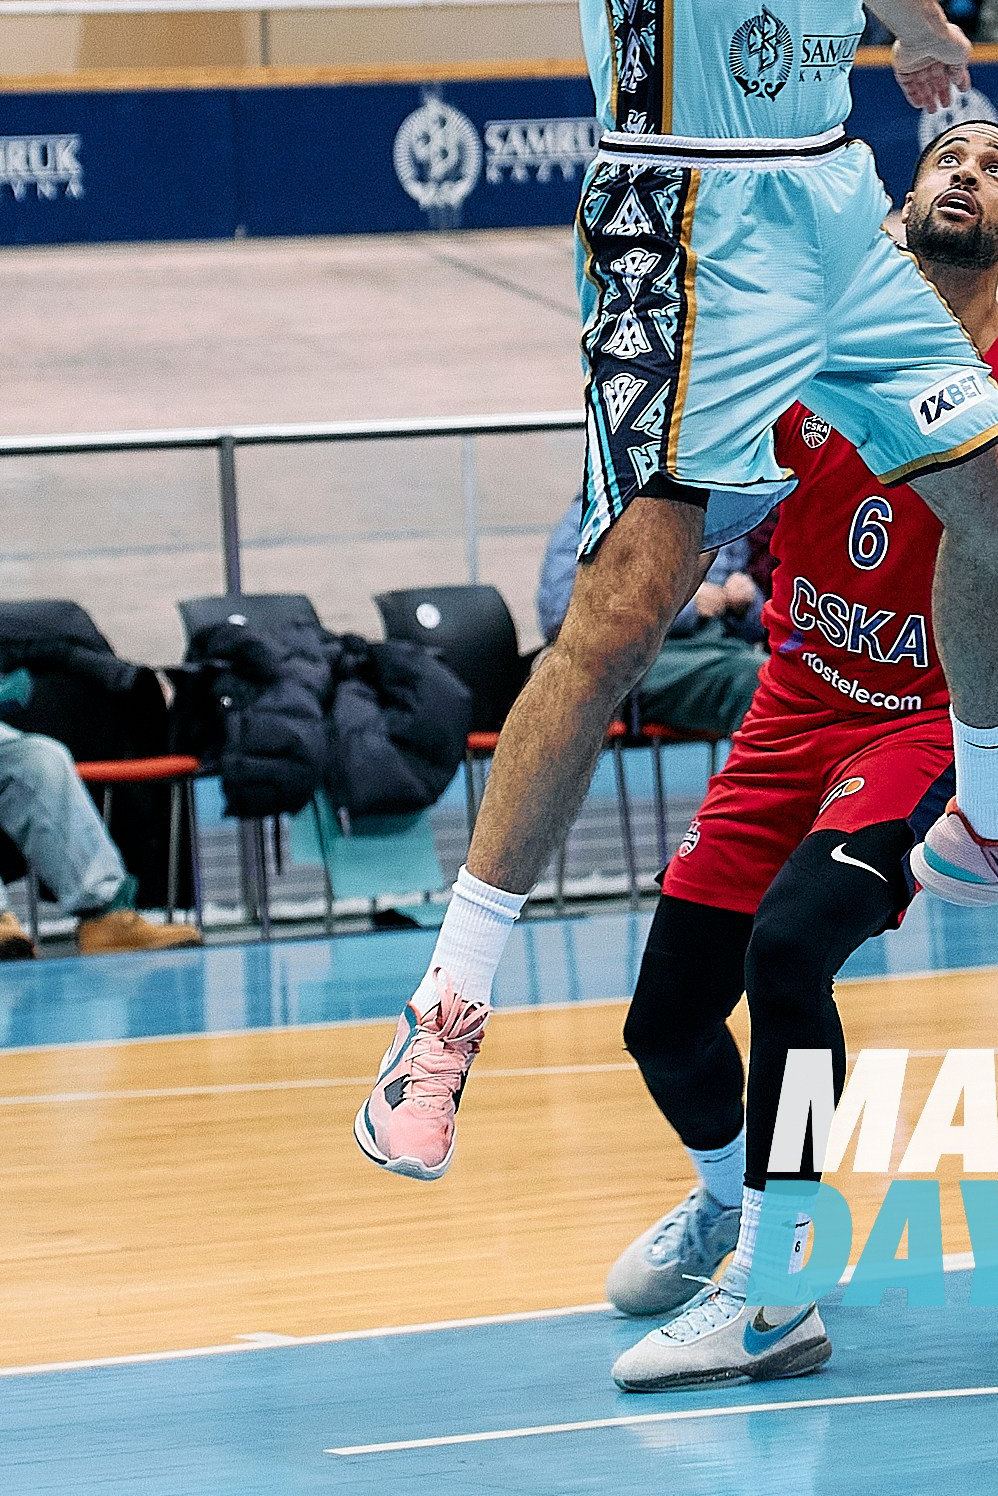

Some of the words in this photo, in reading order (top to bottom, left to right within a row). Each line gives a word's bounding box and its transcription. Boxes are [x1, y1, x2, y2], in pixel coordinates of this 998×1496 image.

[805, 421, 828, 433] CSKA
[849, 495, 893, 571] 6
[790, 576, 929, 668] CSKA
